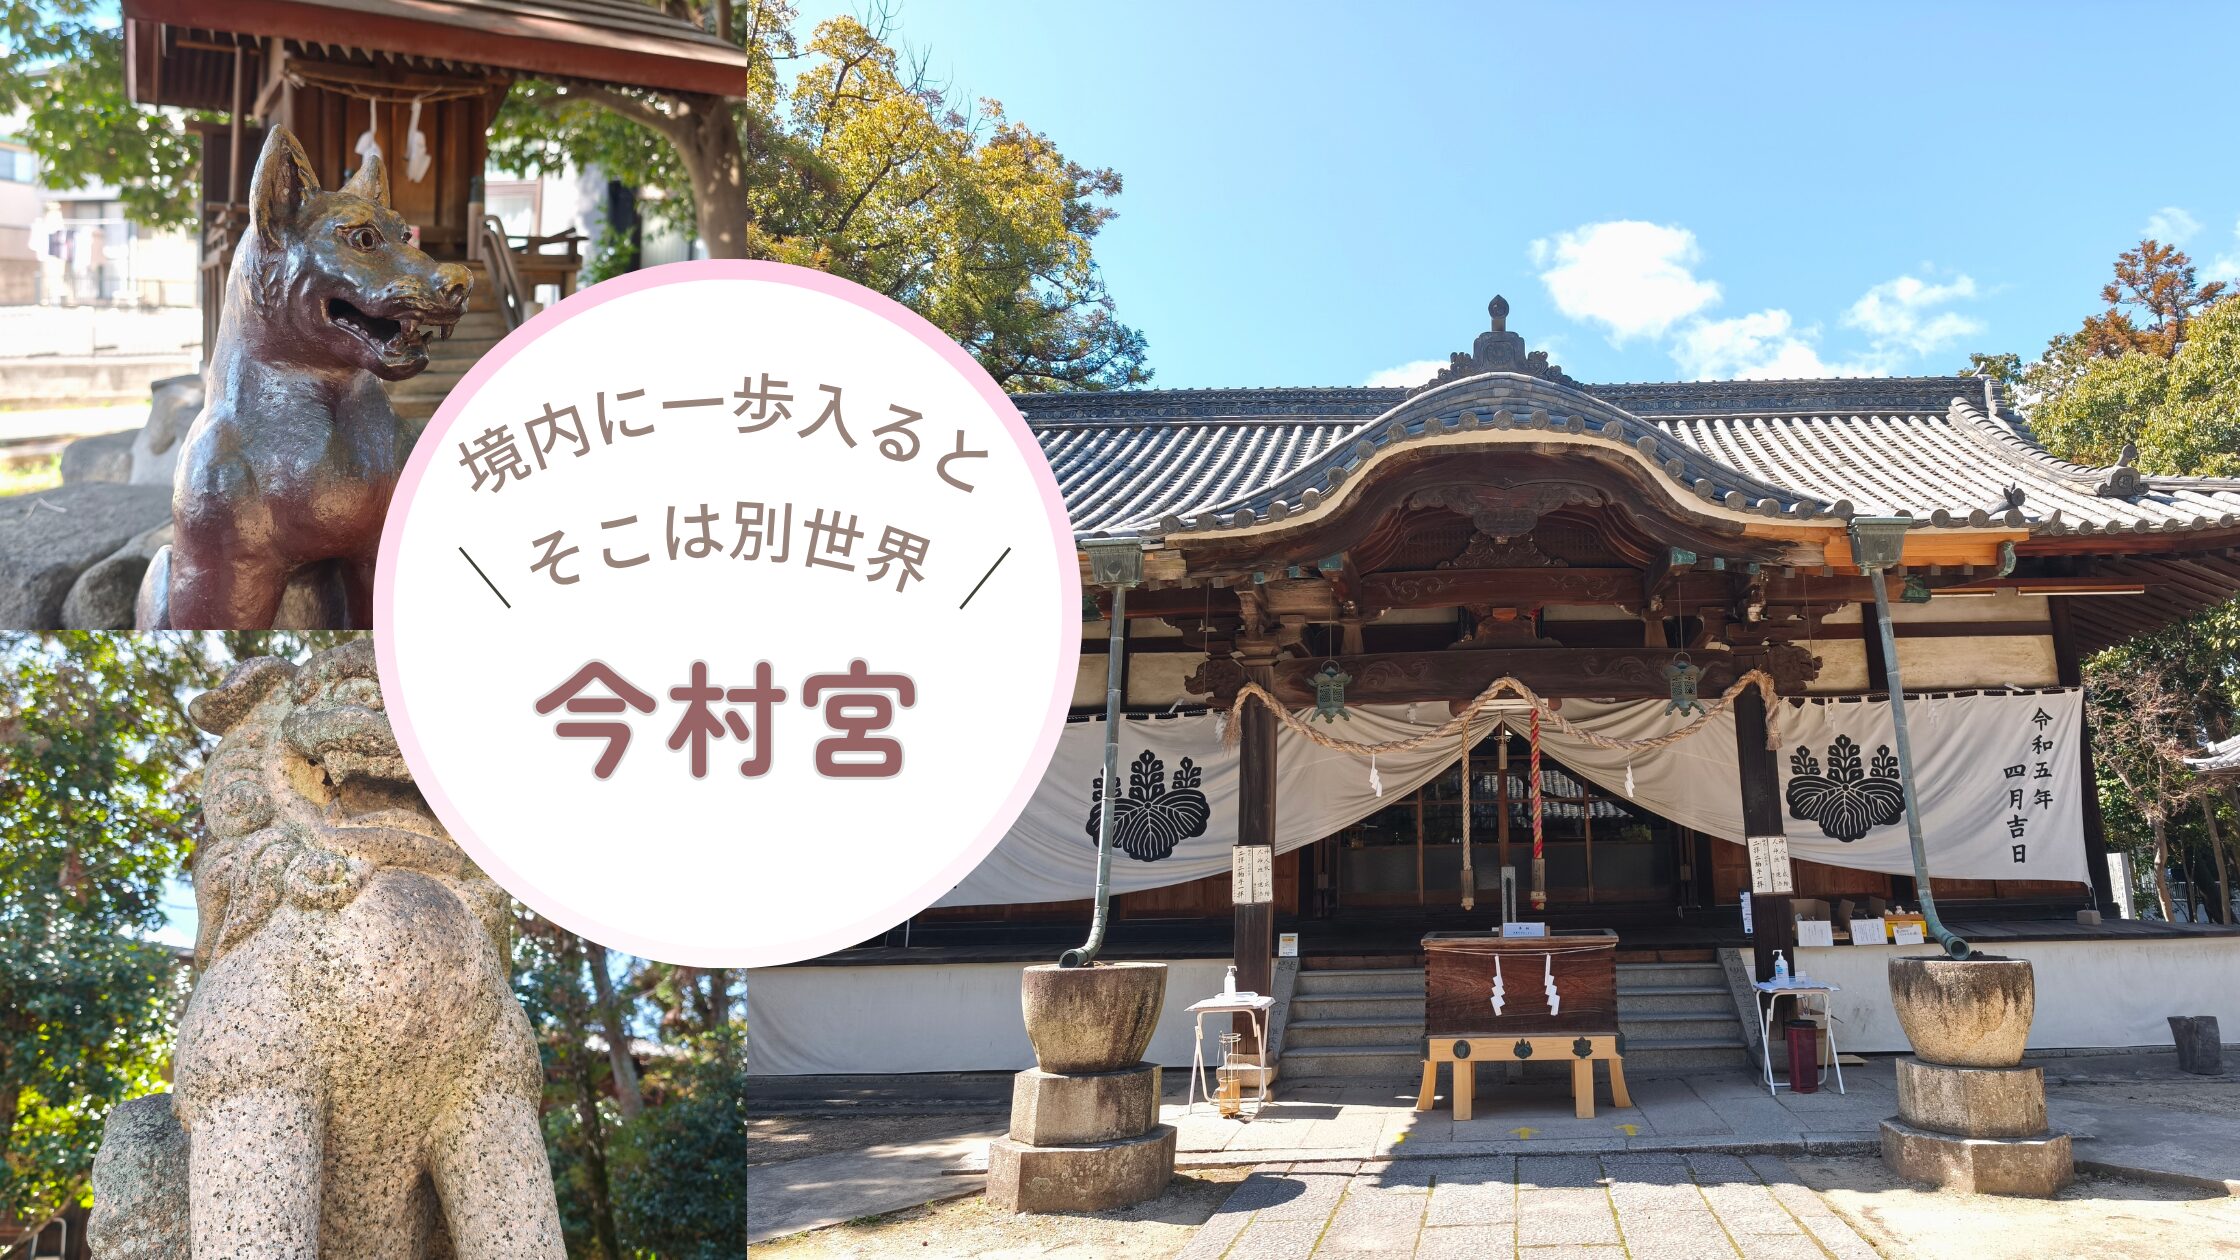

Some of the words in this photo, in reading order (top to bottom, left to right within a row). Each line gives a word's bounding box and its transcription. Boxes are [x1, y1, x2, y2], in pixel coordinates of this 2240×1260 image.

[2031, 706, 2054, 811] 令和五年
[2003, 763, 2028, 864] 四月吉日
